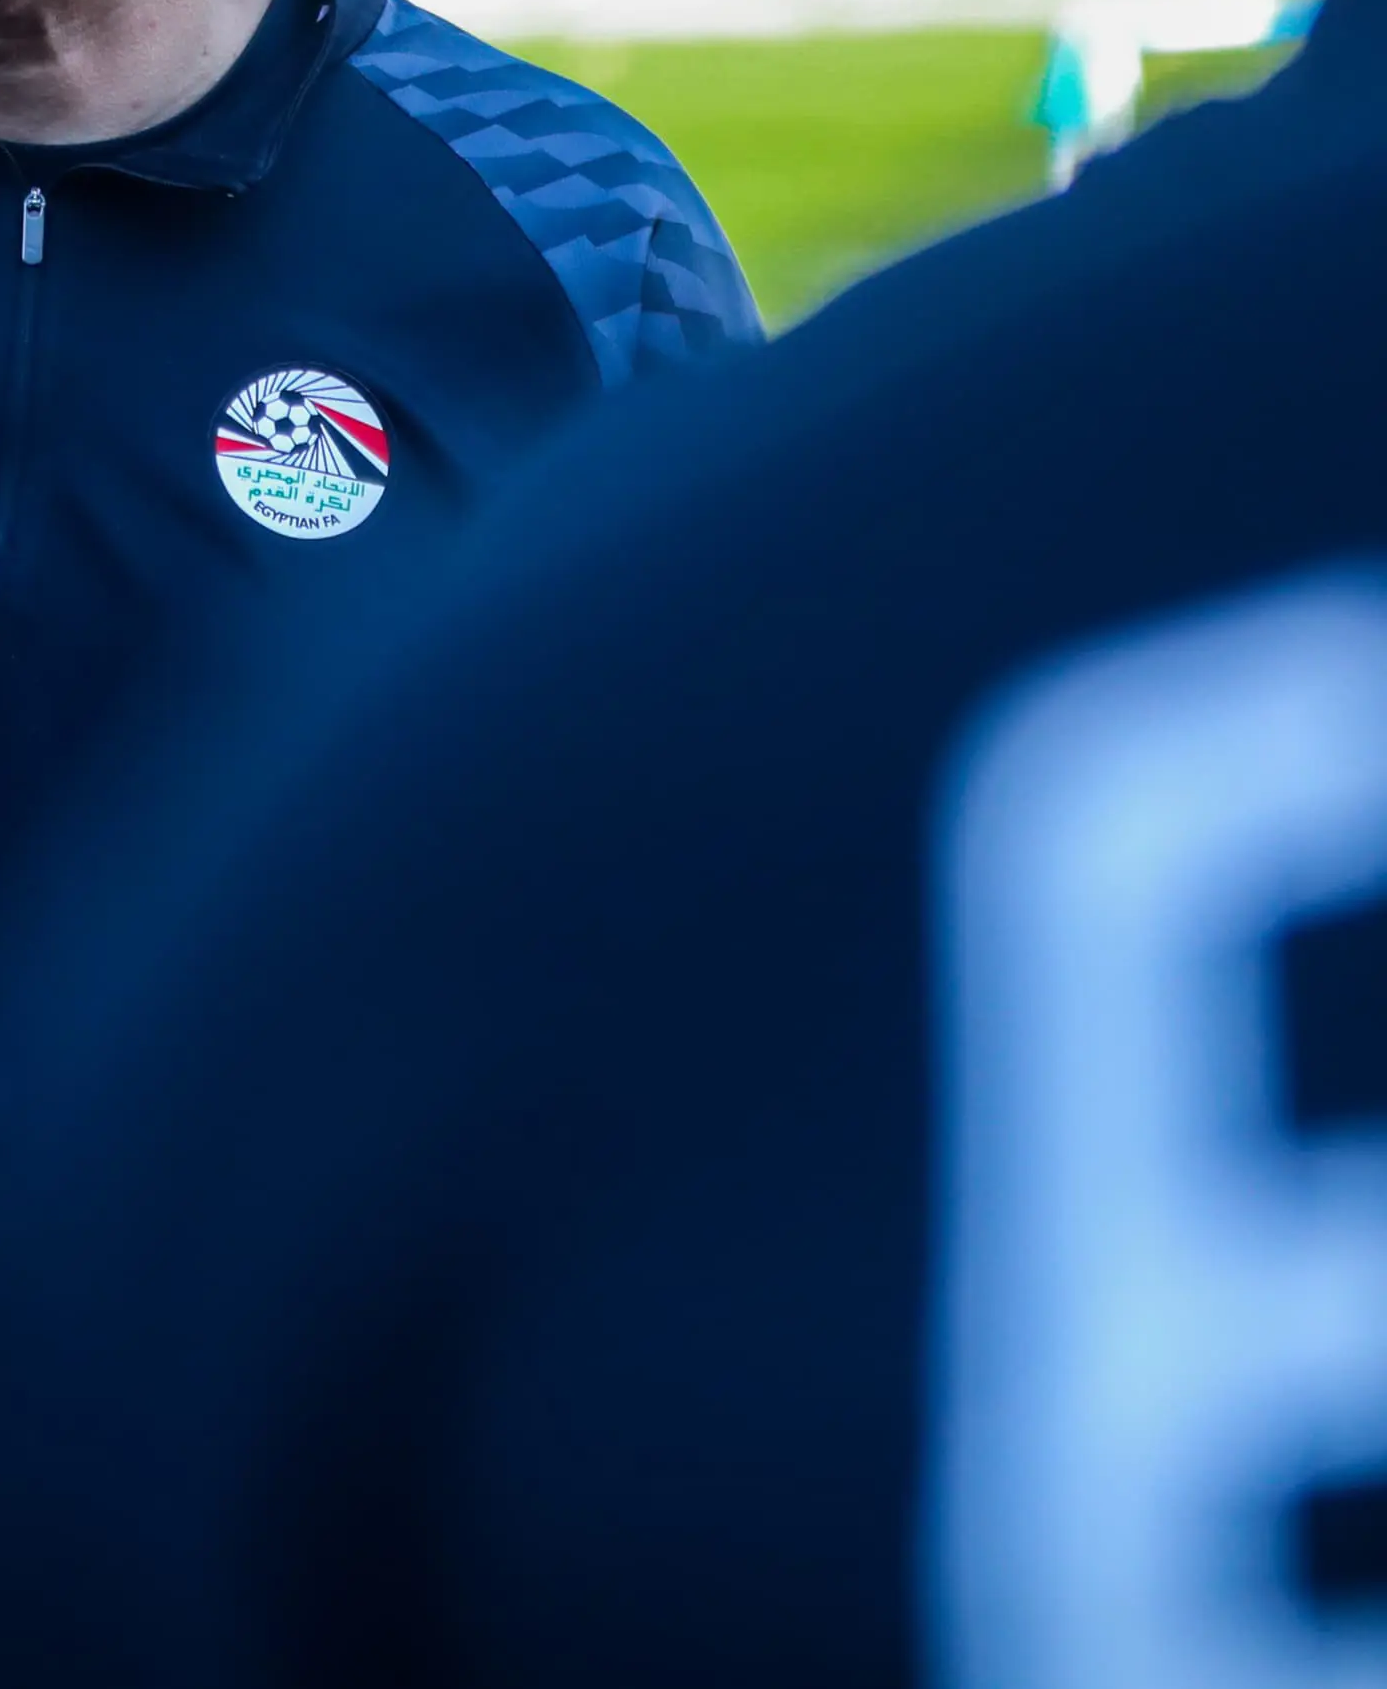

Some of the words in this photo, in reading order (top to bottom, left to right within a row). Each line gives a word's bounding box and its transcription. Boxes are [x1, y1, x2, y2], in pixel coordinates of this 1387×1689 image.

[248, 485, 298, 502] القدم
[313, 475, 365, 498] الاتحاد
[305, 490, 351, 513] لكرة
[253, 500, 320, 529] EGYPTIAN
[322, 513, 341, 527] FA
